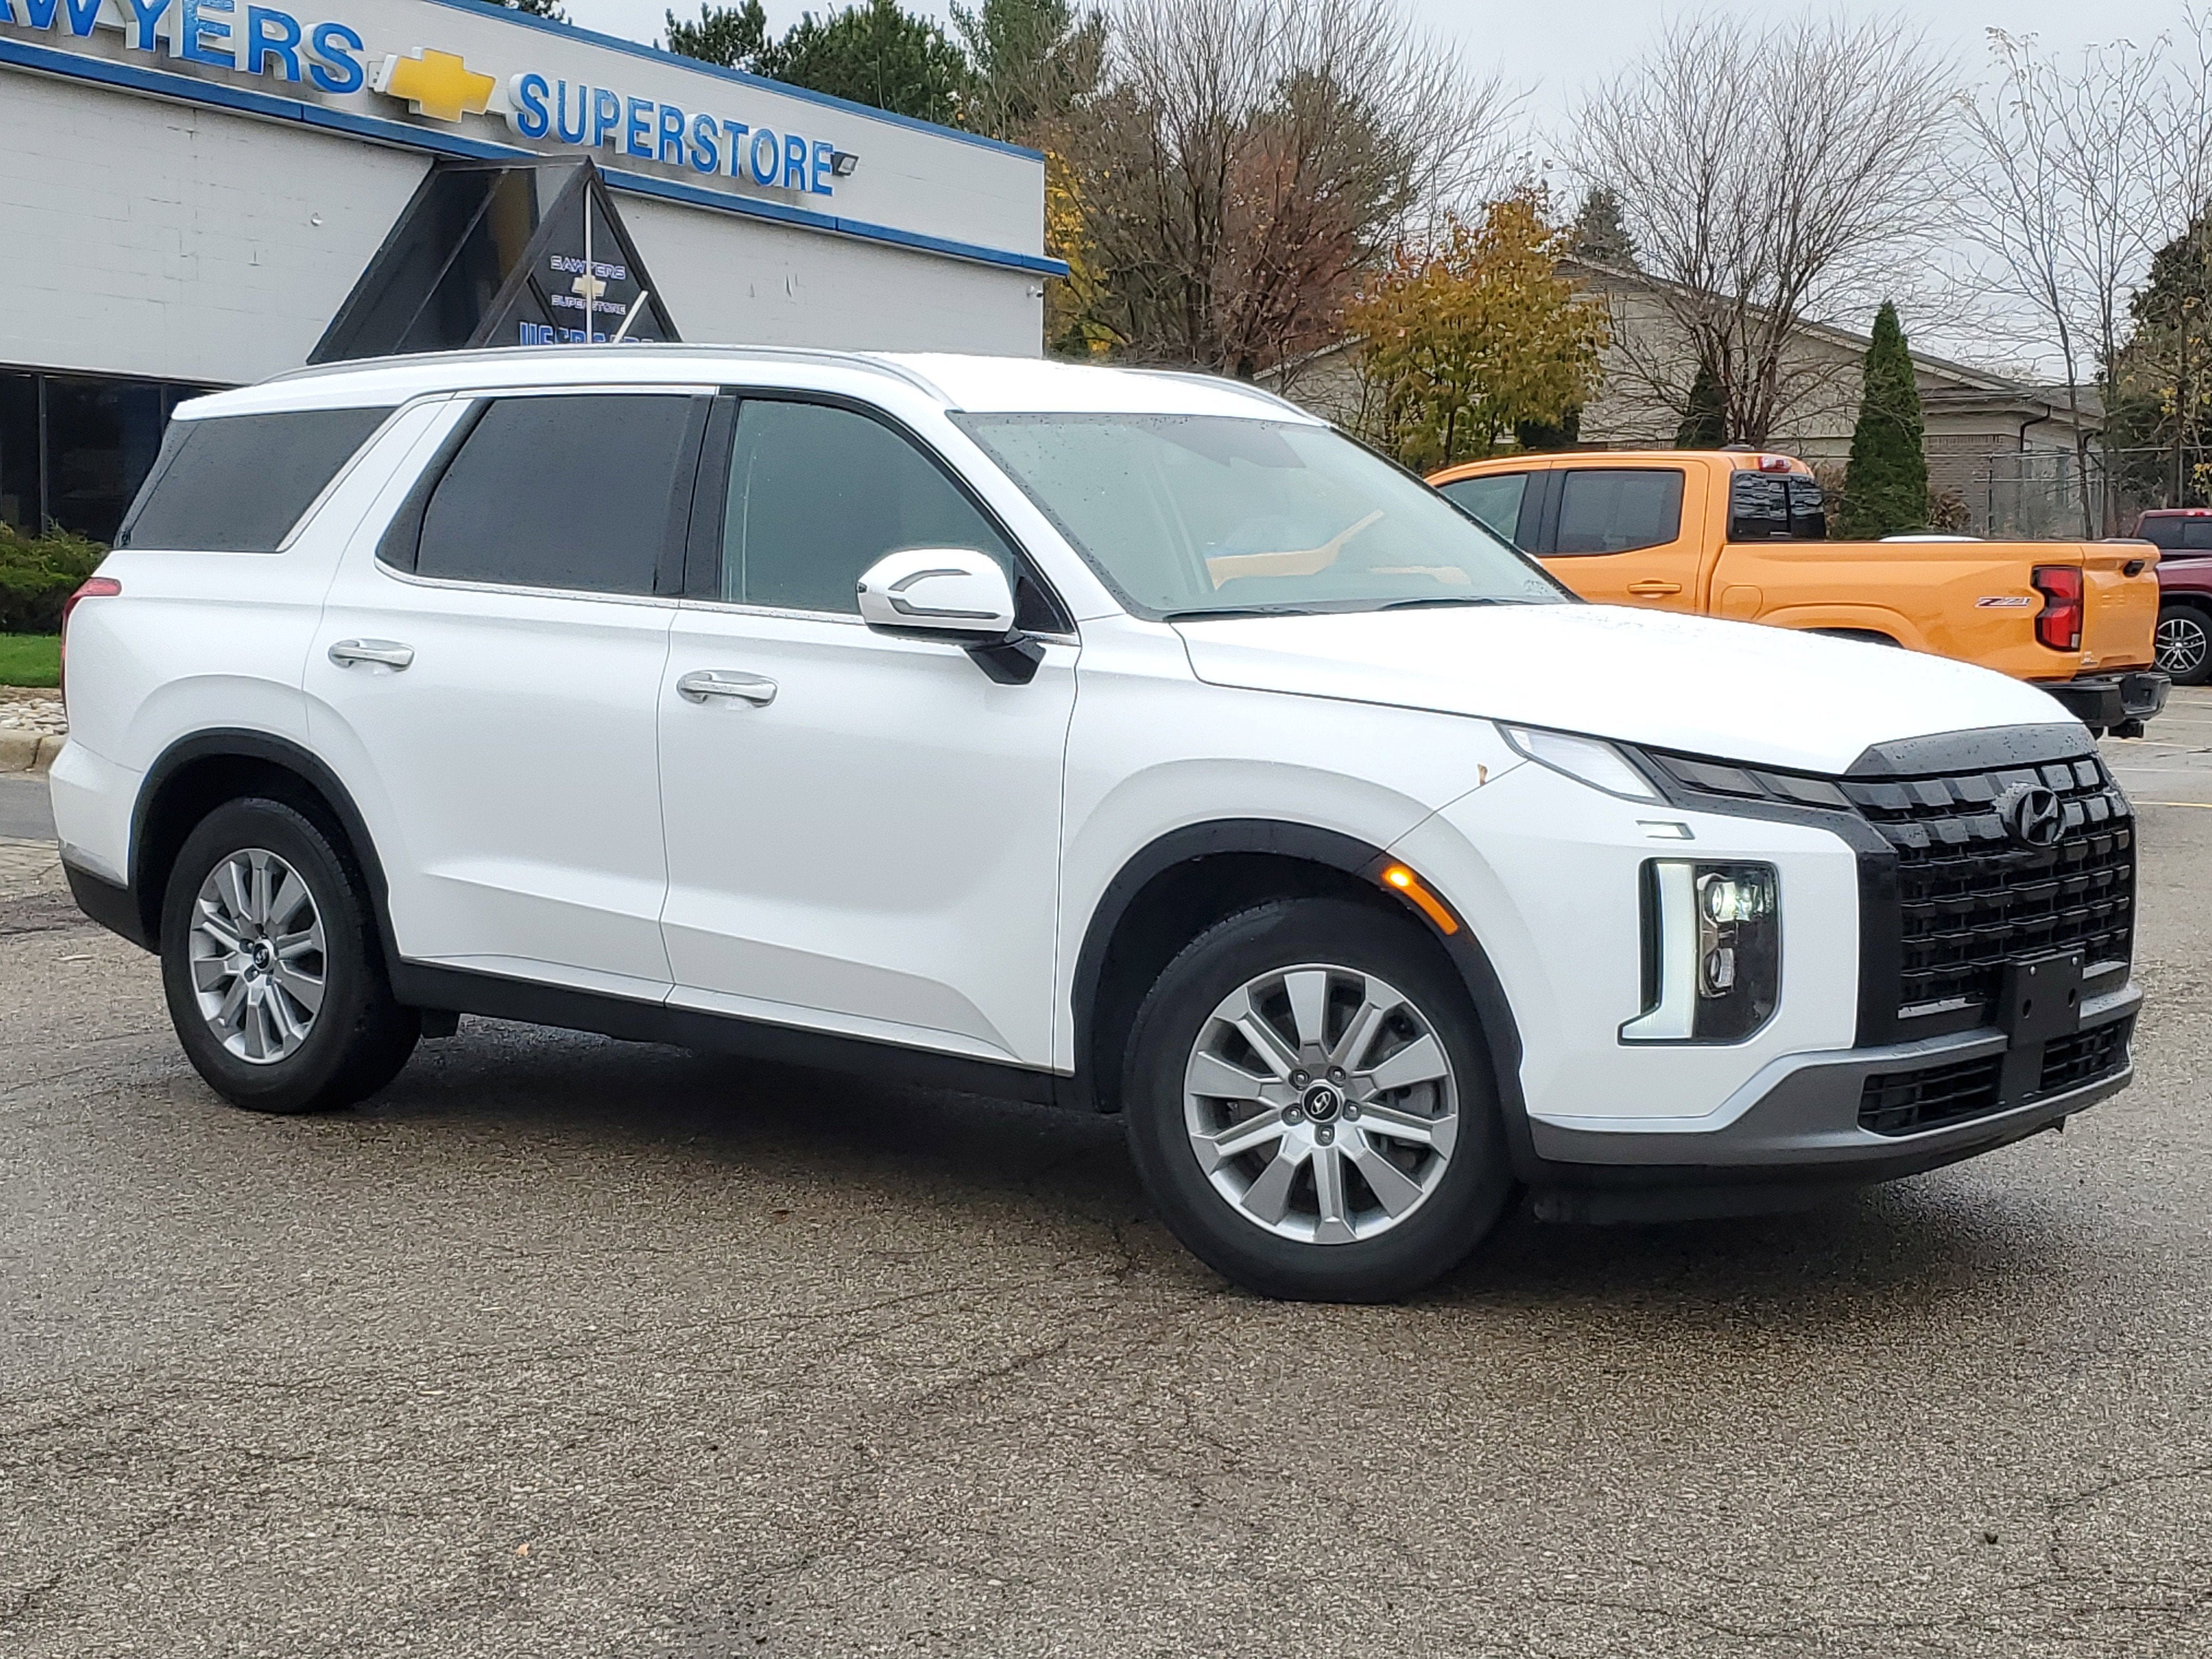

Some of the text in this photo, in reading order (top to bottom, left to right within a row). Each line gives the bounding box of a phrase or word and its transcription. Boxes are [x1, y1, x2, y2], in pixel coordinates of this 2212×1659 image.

[0, 0, 833, 196] WYERS SUPERSTORE
[551, 295, 626, 315] SUPESTORE
